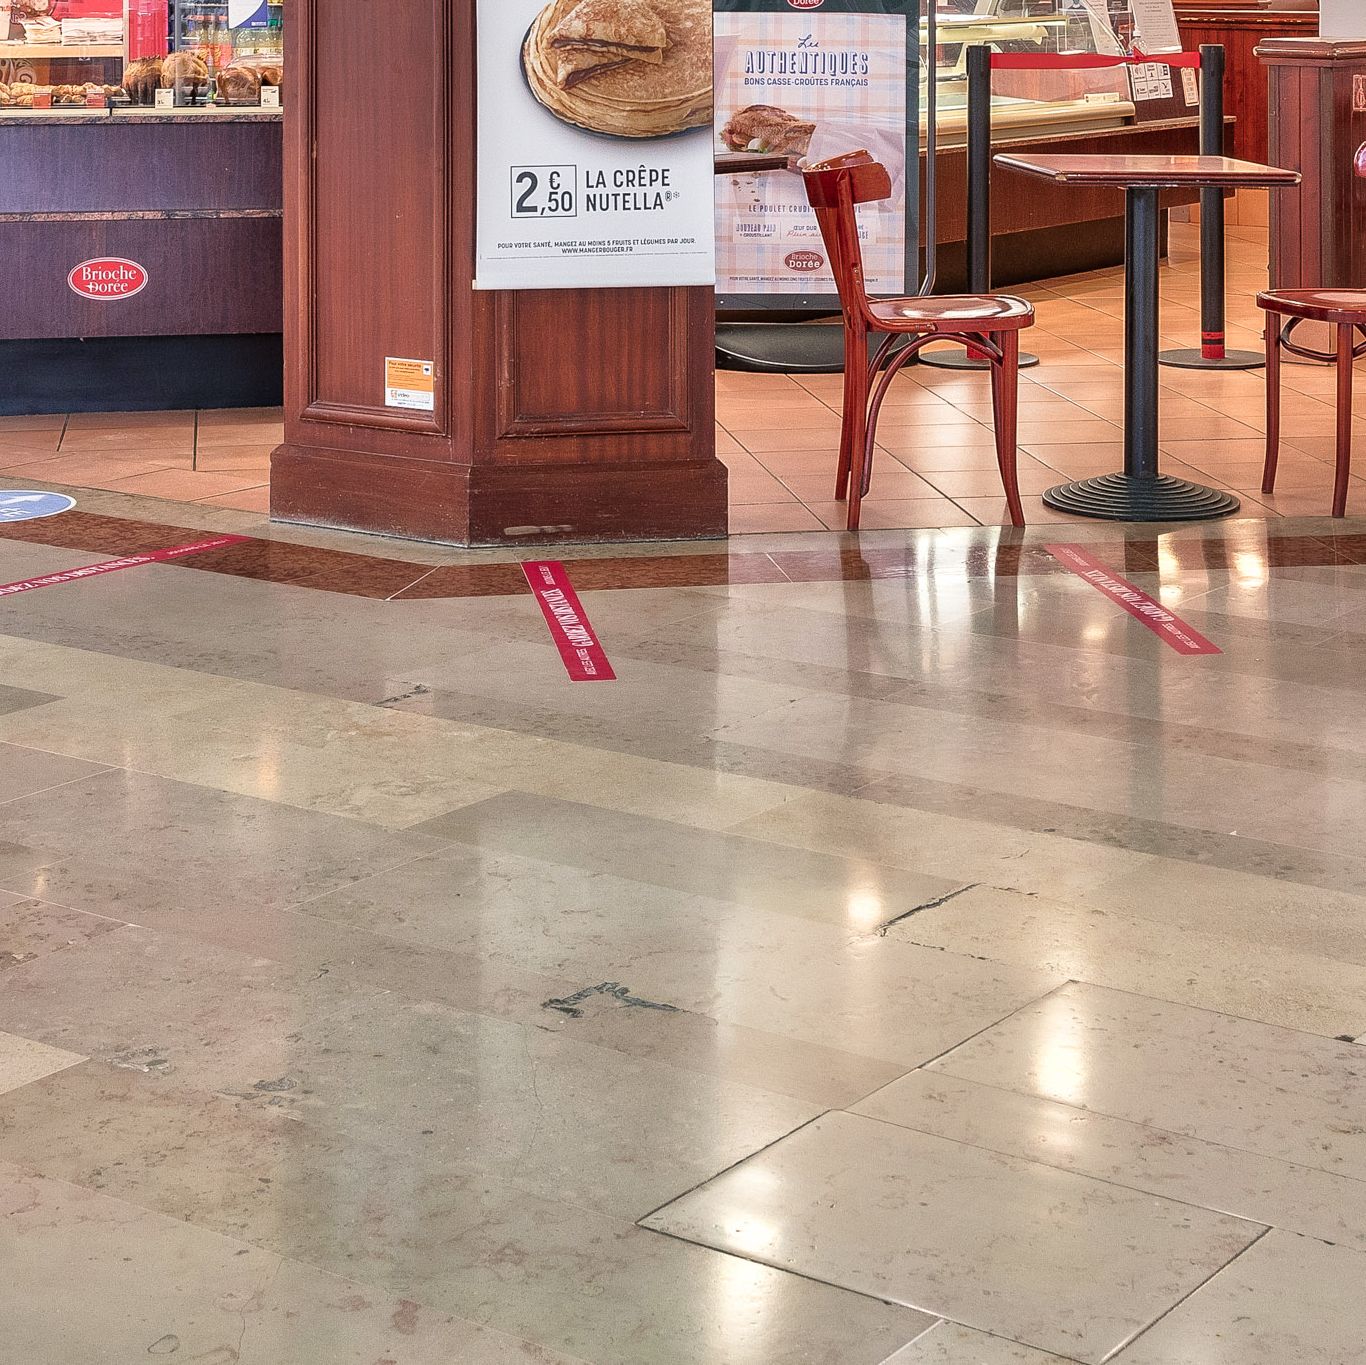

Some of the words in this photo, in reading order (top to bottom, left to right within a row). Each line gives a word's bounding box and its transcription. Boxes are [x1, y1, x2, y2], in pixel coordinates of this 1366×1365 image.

[744, 51, 870, 76] AUTHENTIQUES
[744, 77, 766, 86] BONS
[766, 75, 830, 87] CASSE-CROÛTES
[830, 77, 869, 88] FRANÇAIS
[585, 170, 607, 189] LA
[613, 164, 671, 188] CRÊPE
[748, 205, 757, 213] LE
[759, 204, 787, 213] POULET
[514, 241, 532, 249] VOTRE
[640, 237, 666, 246] LÉGUMES
[561, 246, 633, 254] WWW.MANGERBOUGER.FR
[789, 259, 821, 268] Dorée
[81, 264, 138, 283] Brioche
